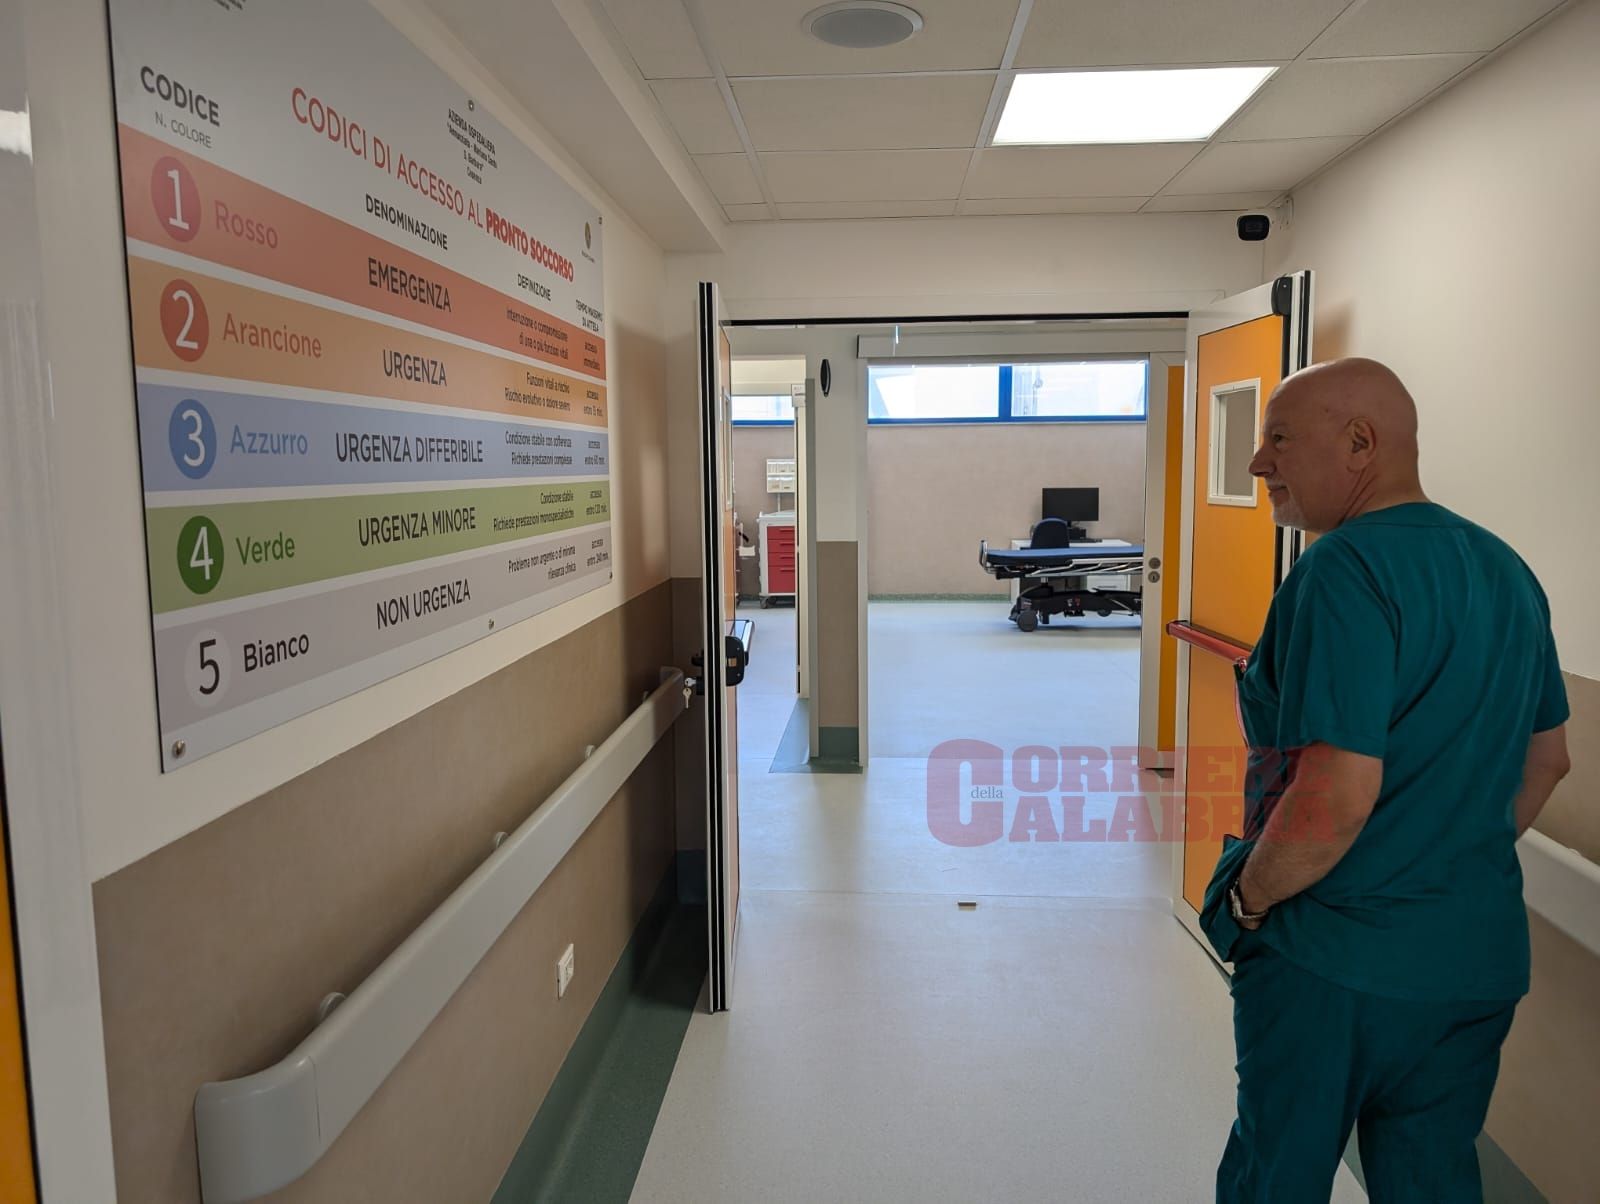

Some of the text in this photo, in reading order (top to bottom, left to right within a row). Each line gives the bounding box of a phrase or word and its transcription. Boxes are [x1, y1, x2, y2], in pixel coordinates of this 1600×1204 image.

[140, 65, 220, 127] CODICE
[154, 111, 212, 149] N. COLORE
[167, 169, 279, 249] 1 Rosso
[292, 87, 367, 160] CODICI
[374, 136, 391, 174] DI
[397, 153, 464, 215] ACCESSO
[468, 199, 483, 228] AL
[485, 207, 528, 255] PRONTO
[530, 236, 574, 282] SOCCORSO
[366, 193, 448, 250] DENOMINAZIONE
[368, 257, 452, 312] EMERGENZA
[517, 273, 551, 301] DEFINIZIONE
[172, 289, 322, 359] 2 Arancione
[383, 349, 447, 387] URGENZA
[181, 409, 308, 467] 3 Azzurro
[335, 432, 484, 463] URGENZA DIFFERIBILE
[190, 526, 296, 581] 4 Verde
[358, 506, 476, 547] URGENZA MINORE
[376, 578, 471, 630] NON URGENZA
[199, 633, 310, 695] 5 Bianco
